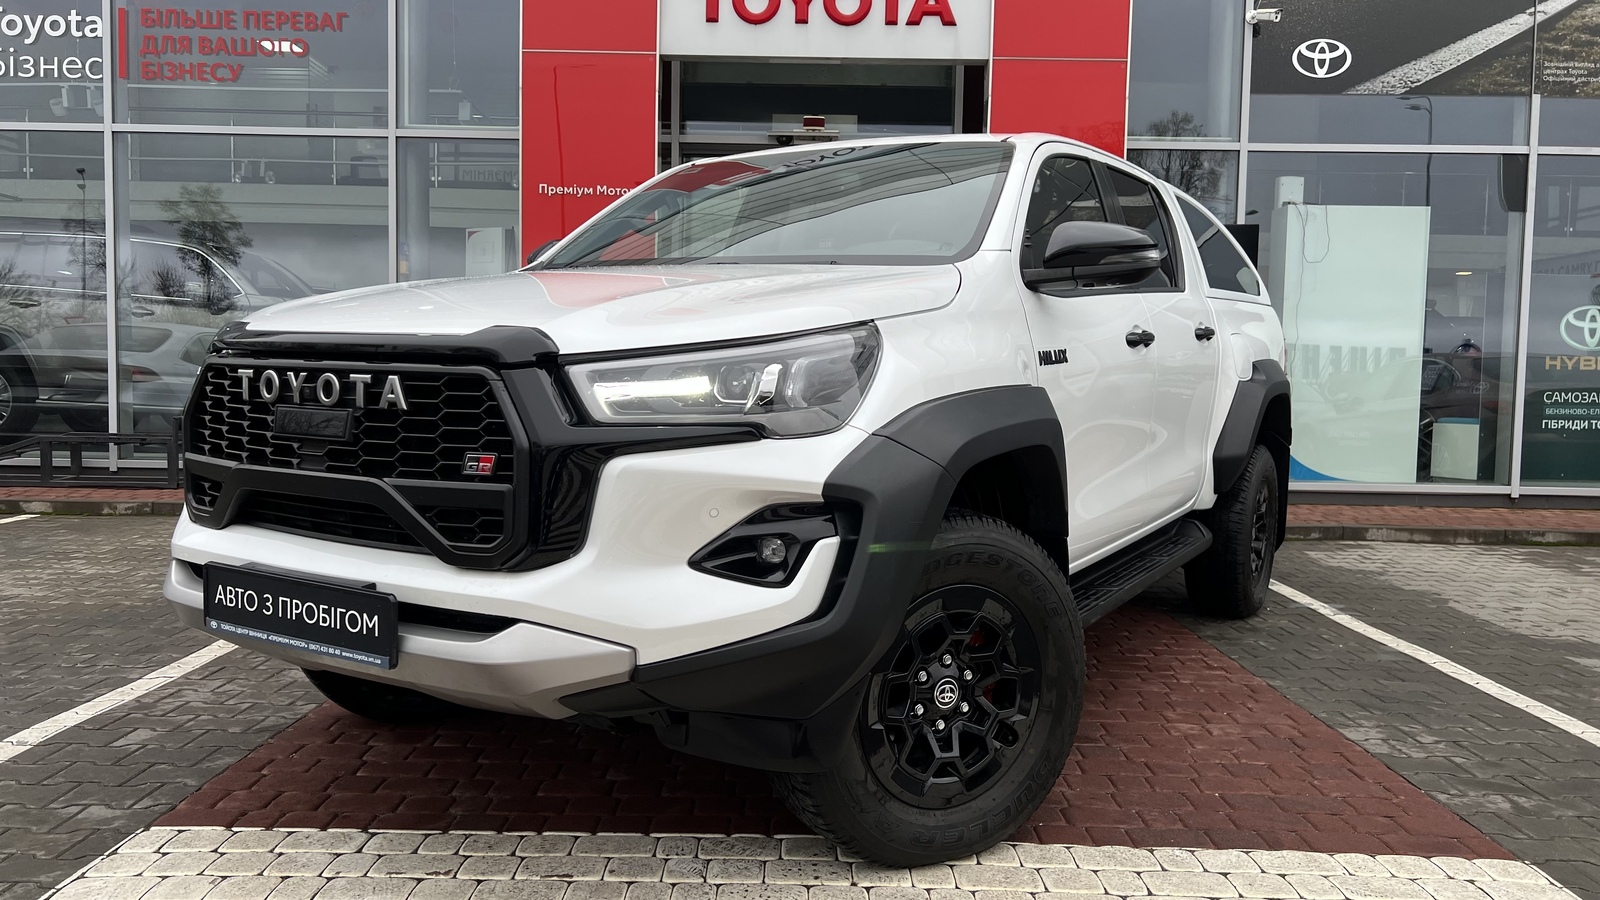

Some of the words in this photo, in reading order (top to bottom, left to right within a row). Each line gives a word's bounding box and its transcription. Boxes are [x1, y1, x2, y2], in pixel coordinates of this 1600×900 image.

[0, 6, 103, 45] oyota
[140, 8, 236, 29] БІЛЬШЕ
[242, 10, 348, 31] ПЕРЕВАГ
[139, 34, 190, 57] ДЛЯ
[198, 36, 309, 57] ВАШОГО
[141, 61, 242, 82] БІЗНЕСУ
[539, 183, 593, 197] Преміум
[1037, 349, 1069, 366] HILUX
[1545, 355, 1600, 371] HYB
[237, 368, 409, 410] TOYOTA
[1543, 391, 1600, 403] САМОЗА
[1542, 420, 1589, 430] ГІБРИДИ
[465, 462, 492, 472] GR
[214, 584, 258, 612] АВТО
[278, 597, 379, 637] ПРОБІГОМ
